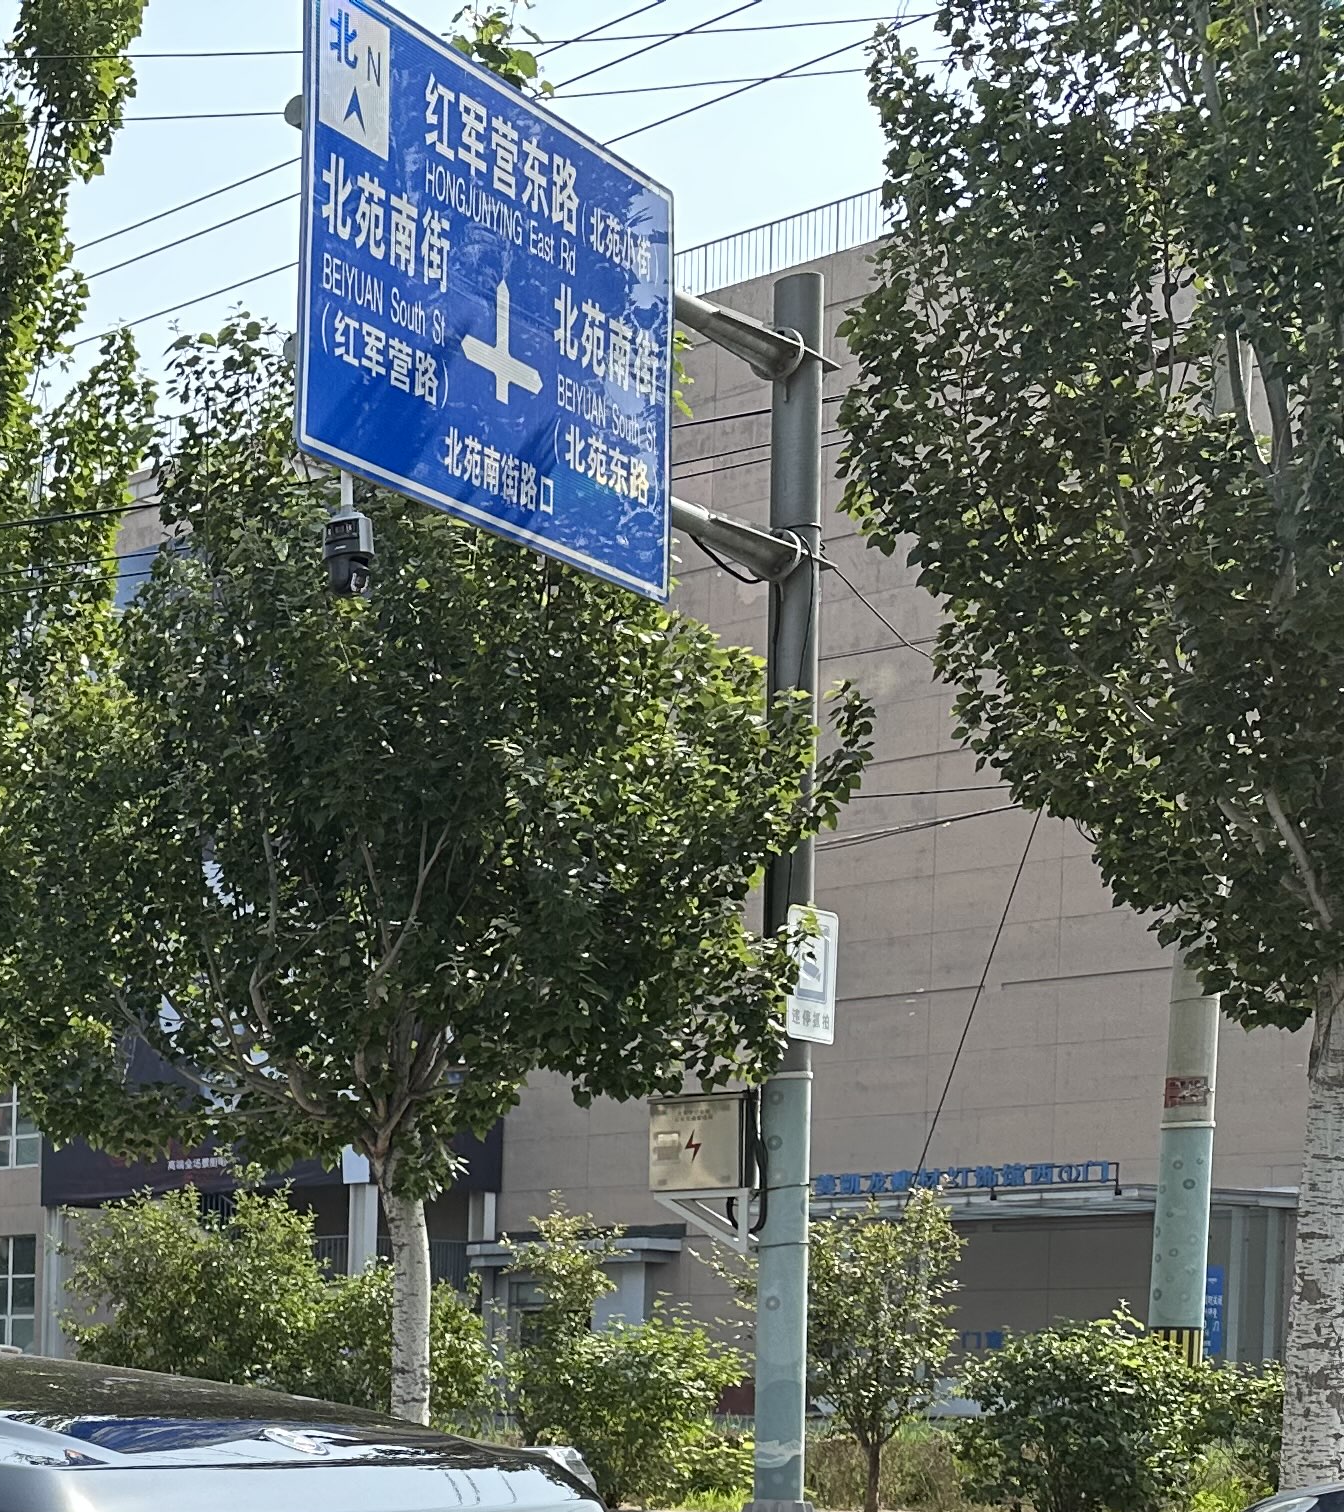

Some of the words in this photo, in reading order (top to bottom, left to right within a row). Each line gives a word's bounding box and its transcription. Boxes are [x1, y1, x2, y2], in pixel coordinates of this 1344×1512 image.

[329, 8, 358, 69] 北
[367, 45, 381, 87] N
[425, 72, 580, 236] 红军营东路
[321, 152, 451, 293] 北苑南街
[425, 159, 523, 246] HONGJUNYING
[529, 220, 555, 264] East
[560, 238, 577, 276] Rd
[322, 252, 384, 316] BEIYUAN
[390, 287, 426, 336] South
[432, 309, 446, 347] St
[554, 283, 660, 405] 北苑南街
[557, 373, 606, 428] BEIYUAN
[611, 403, 641, 444] South
[645, 421, 657, 454] St
[444, 426, 555, 515] 北苑南街路口
